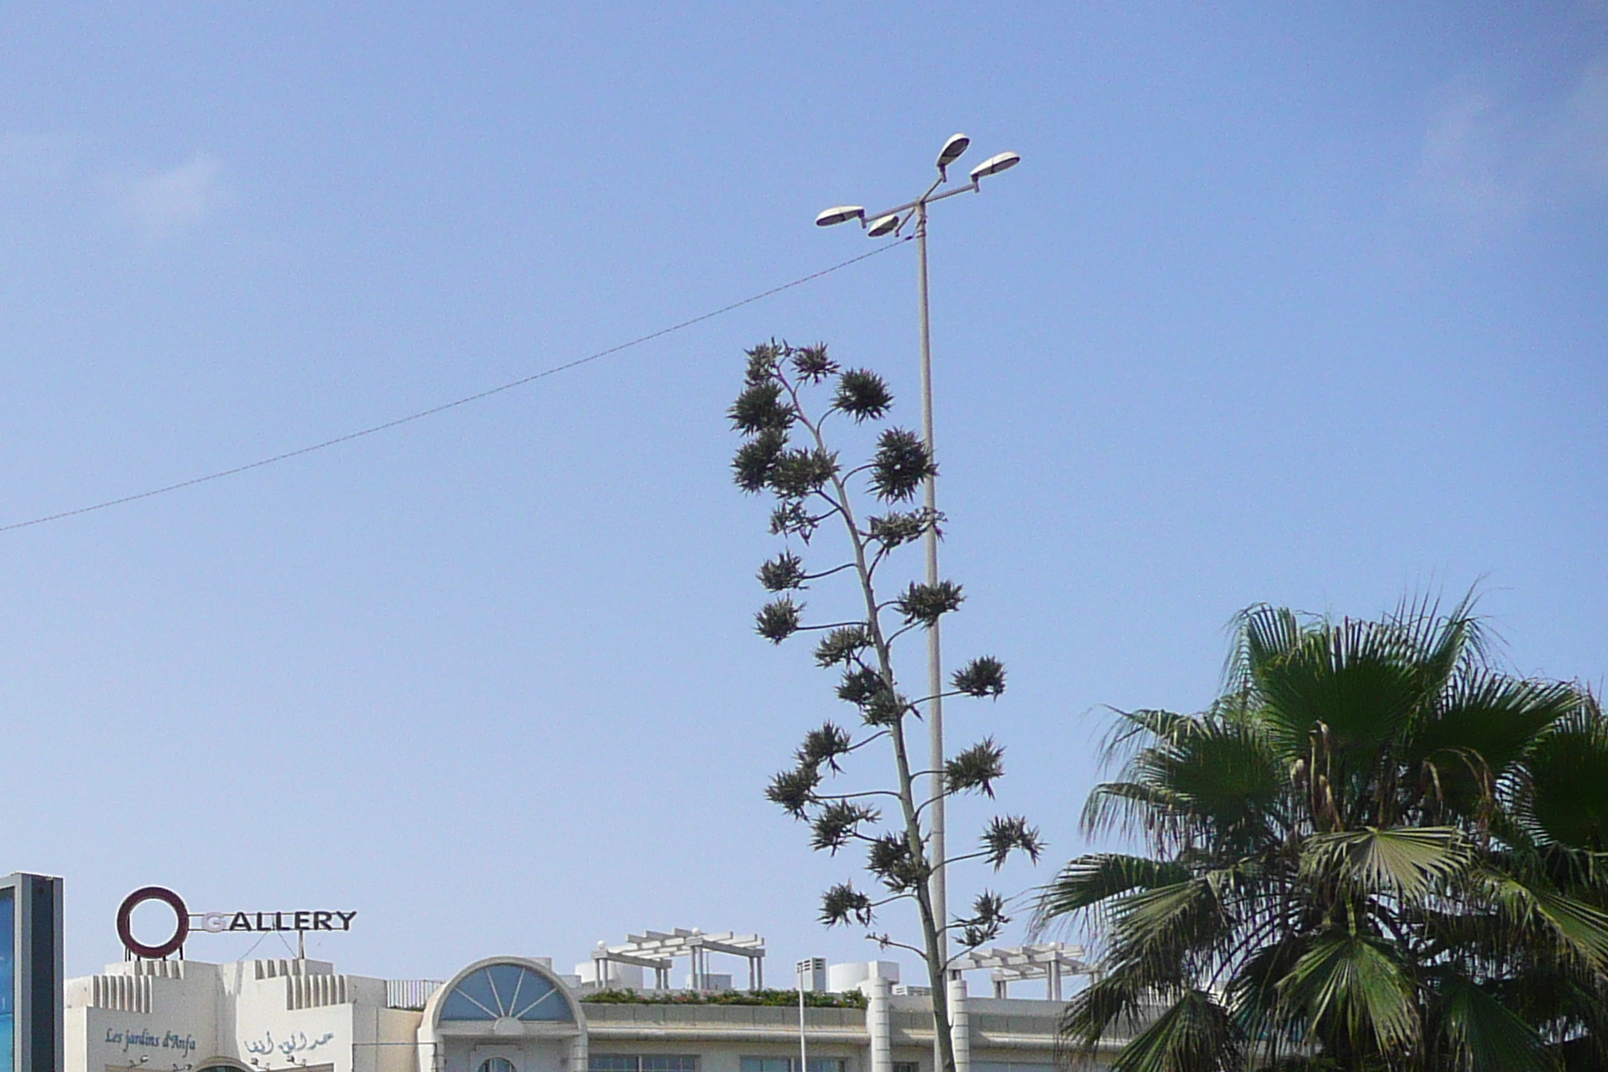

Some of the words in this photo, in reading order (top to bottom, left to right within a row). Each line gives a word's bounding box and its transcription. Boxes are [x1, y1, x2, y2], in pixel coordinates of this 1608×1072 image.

[201, 911, 357, 933] GALLERY
[105, 1028, 123, 1043] Les
[123, 1028, 159, 1052] jardins
[162, 1030, 196, 1058] d'Anfa
